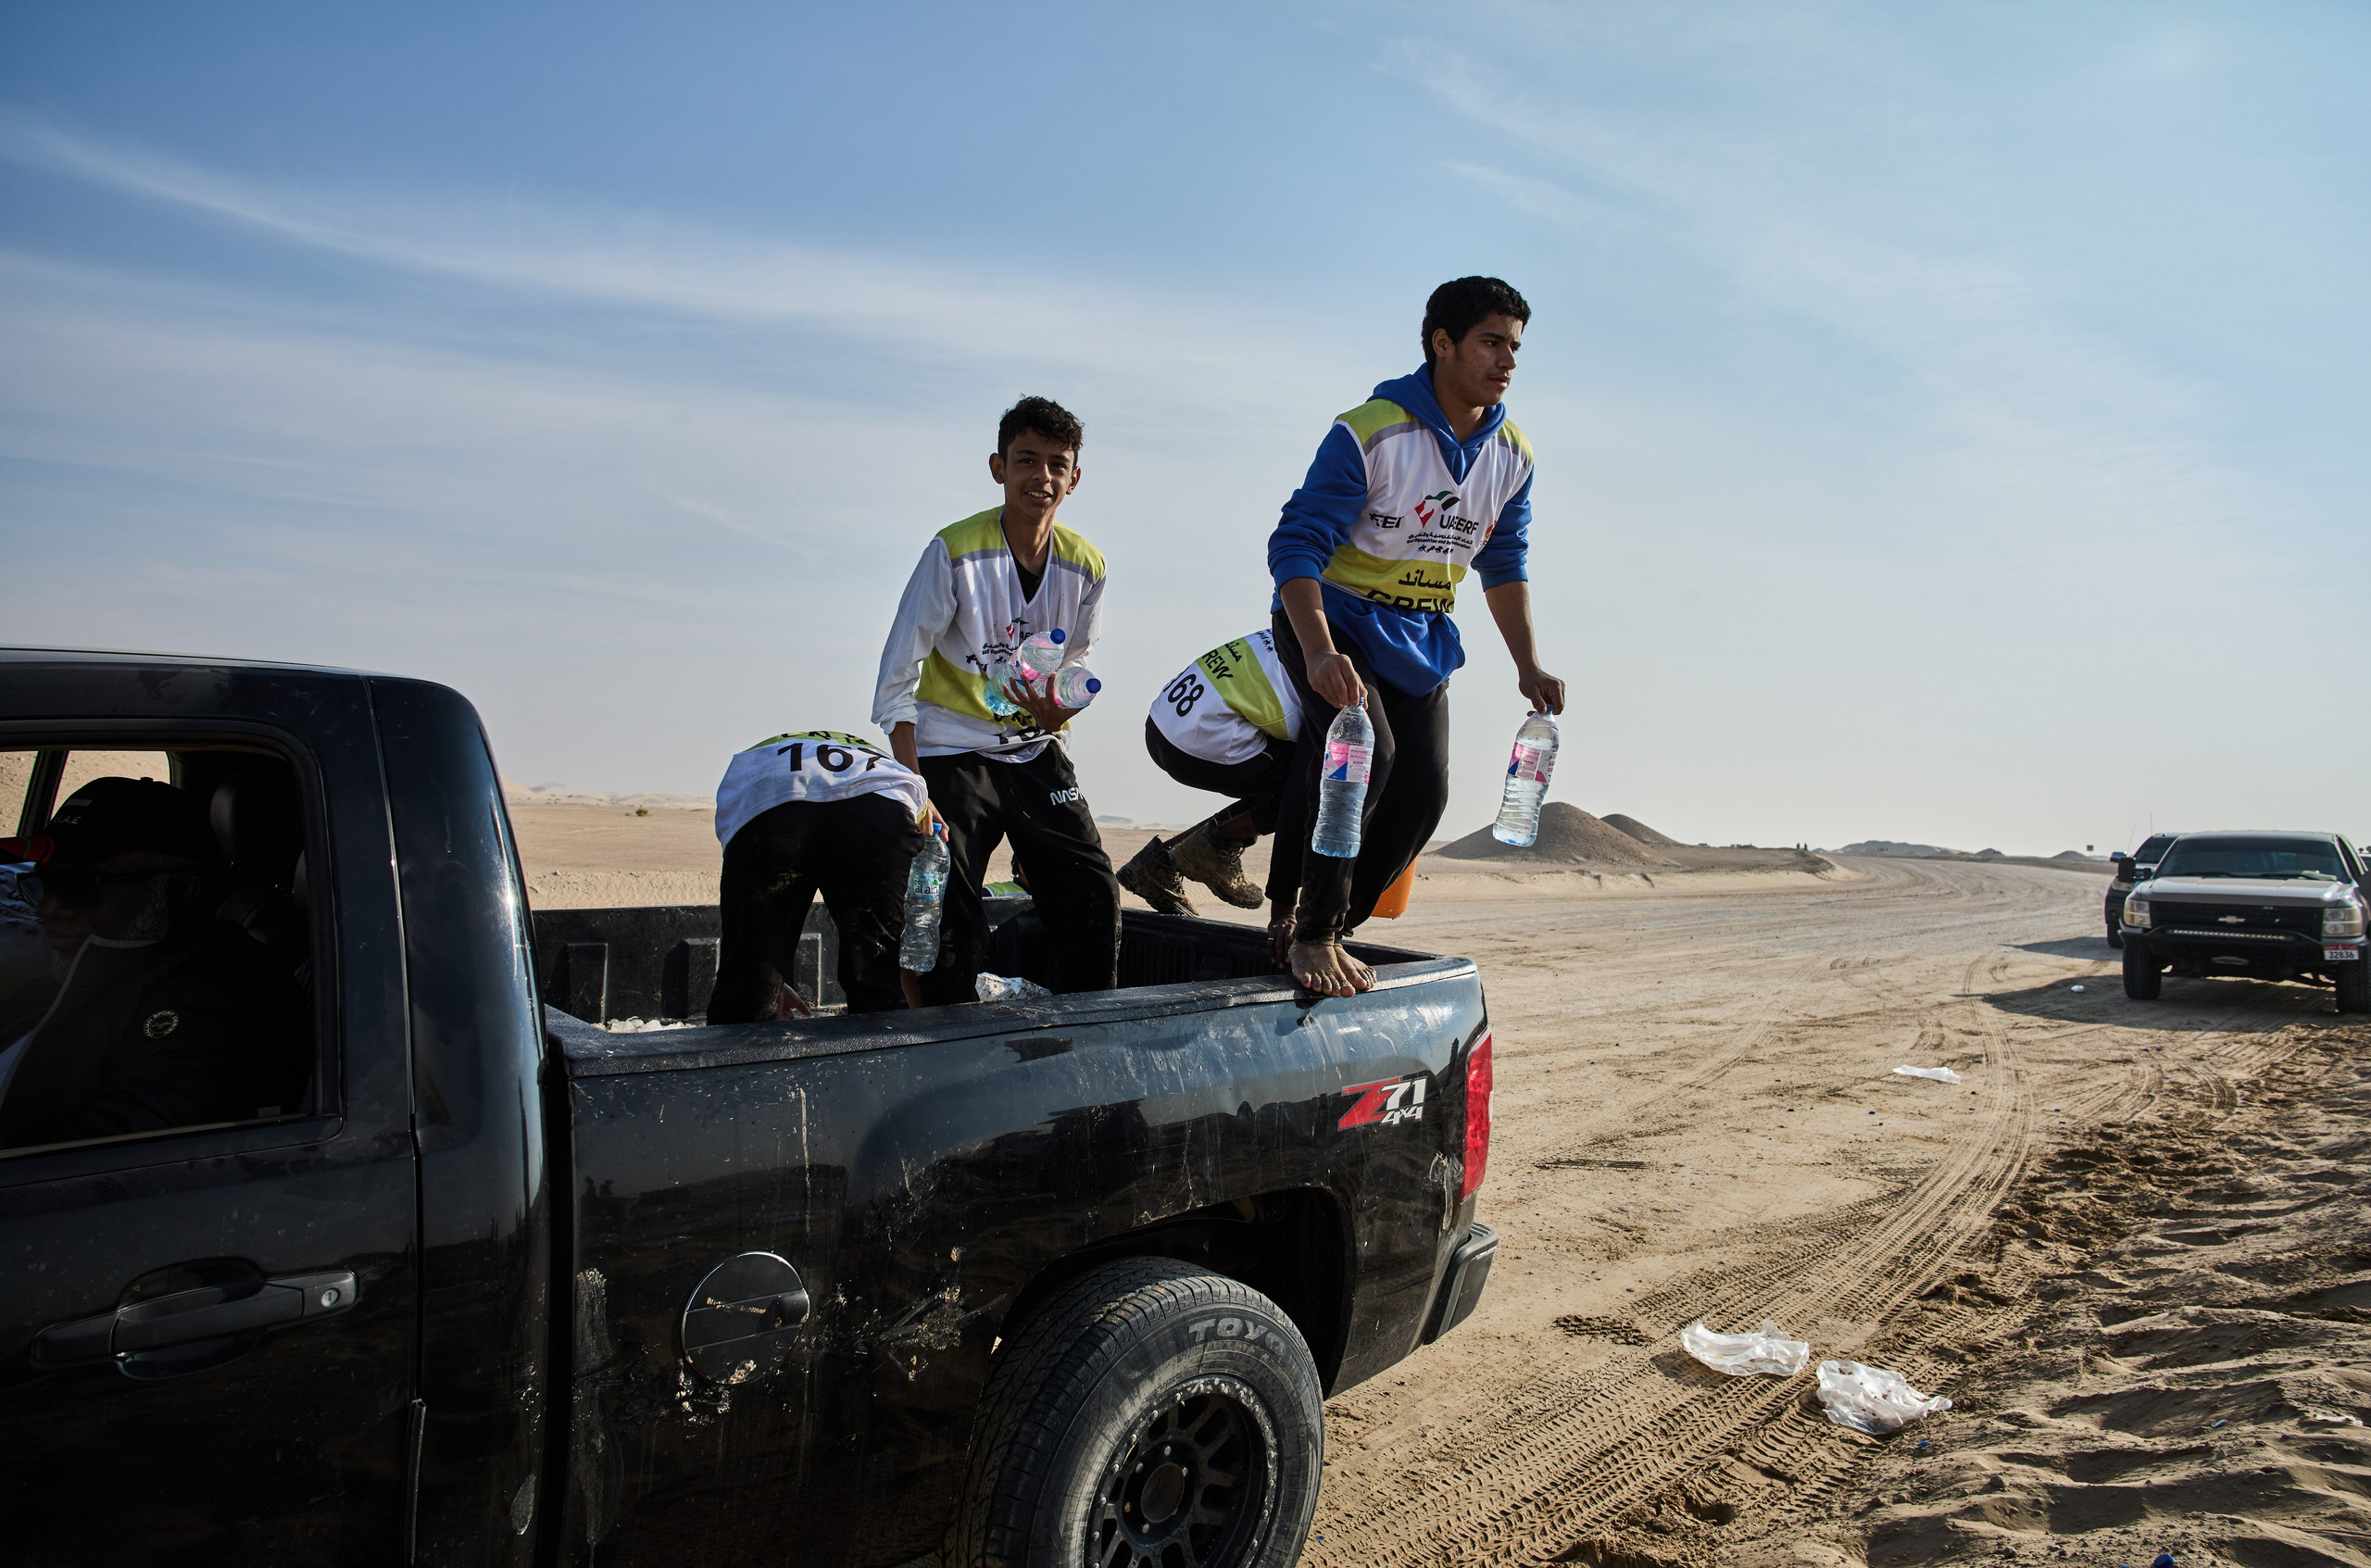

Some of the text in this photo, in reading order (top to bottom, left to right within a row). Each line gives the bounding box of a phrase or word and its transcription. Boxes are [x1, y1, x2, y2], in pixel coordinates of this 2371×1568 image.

[1201, 648, 1234, 680] REW
[777, 742, 891, 773] 167
[1337, 1075, 1428, 1131] Z71
[1187, 1316, 1287, 1356] TOYO
